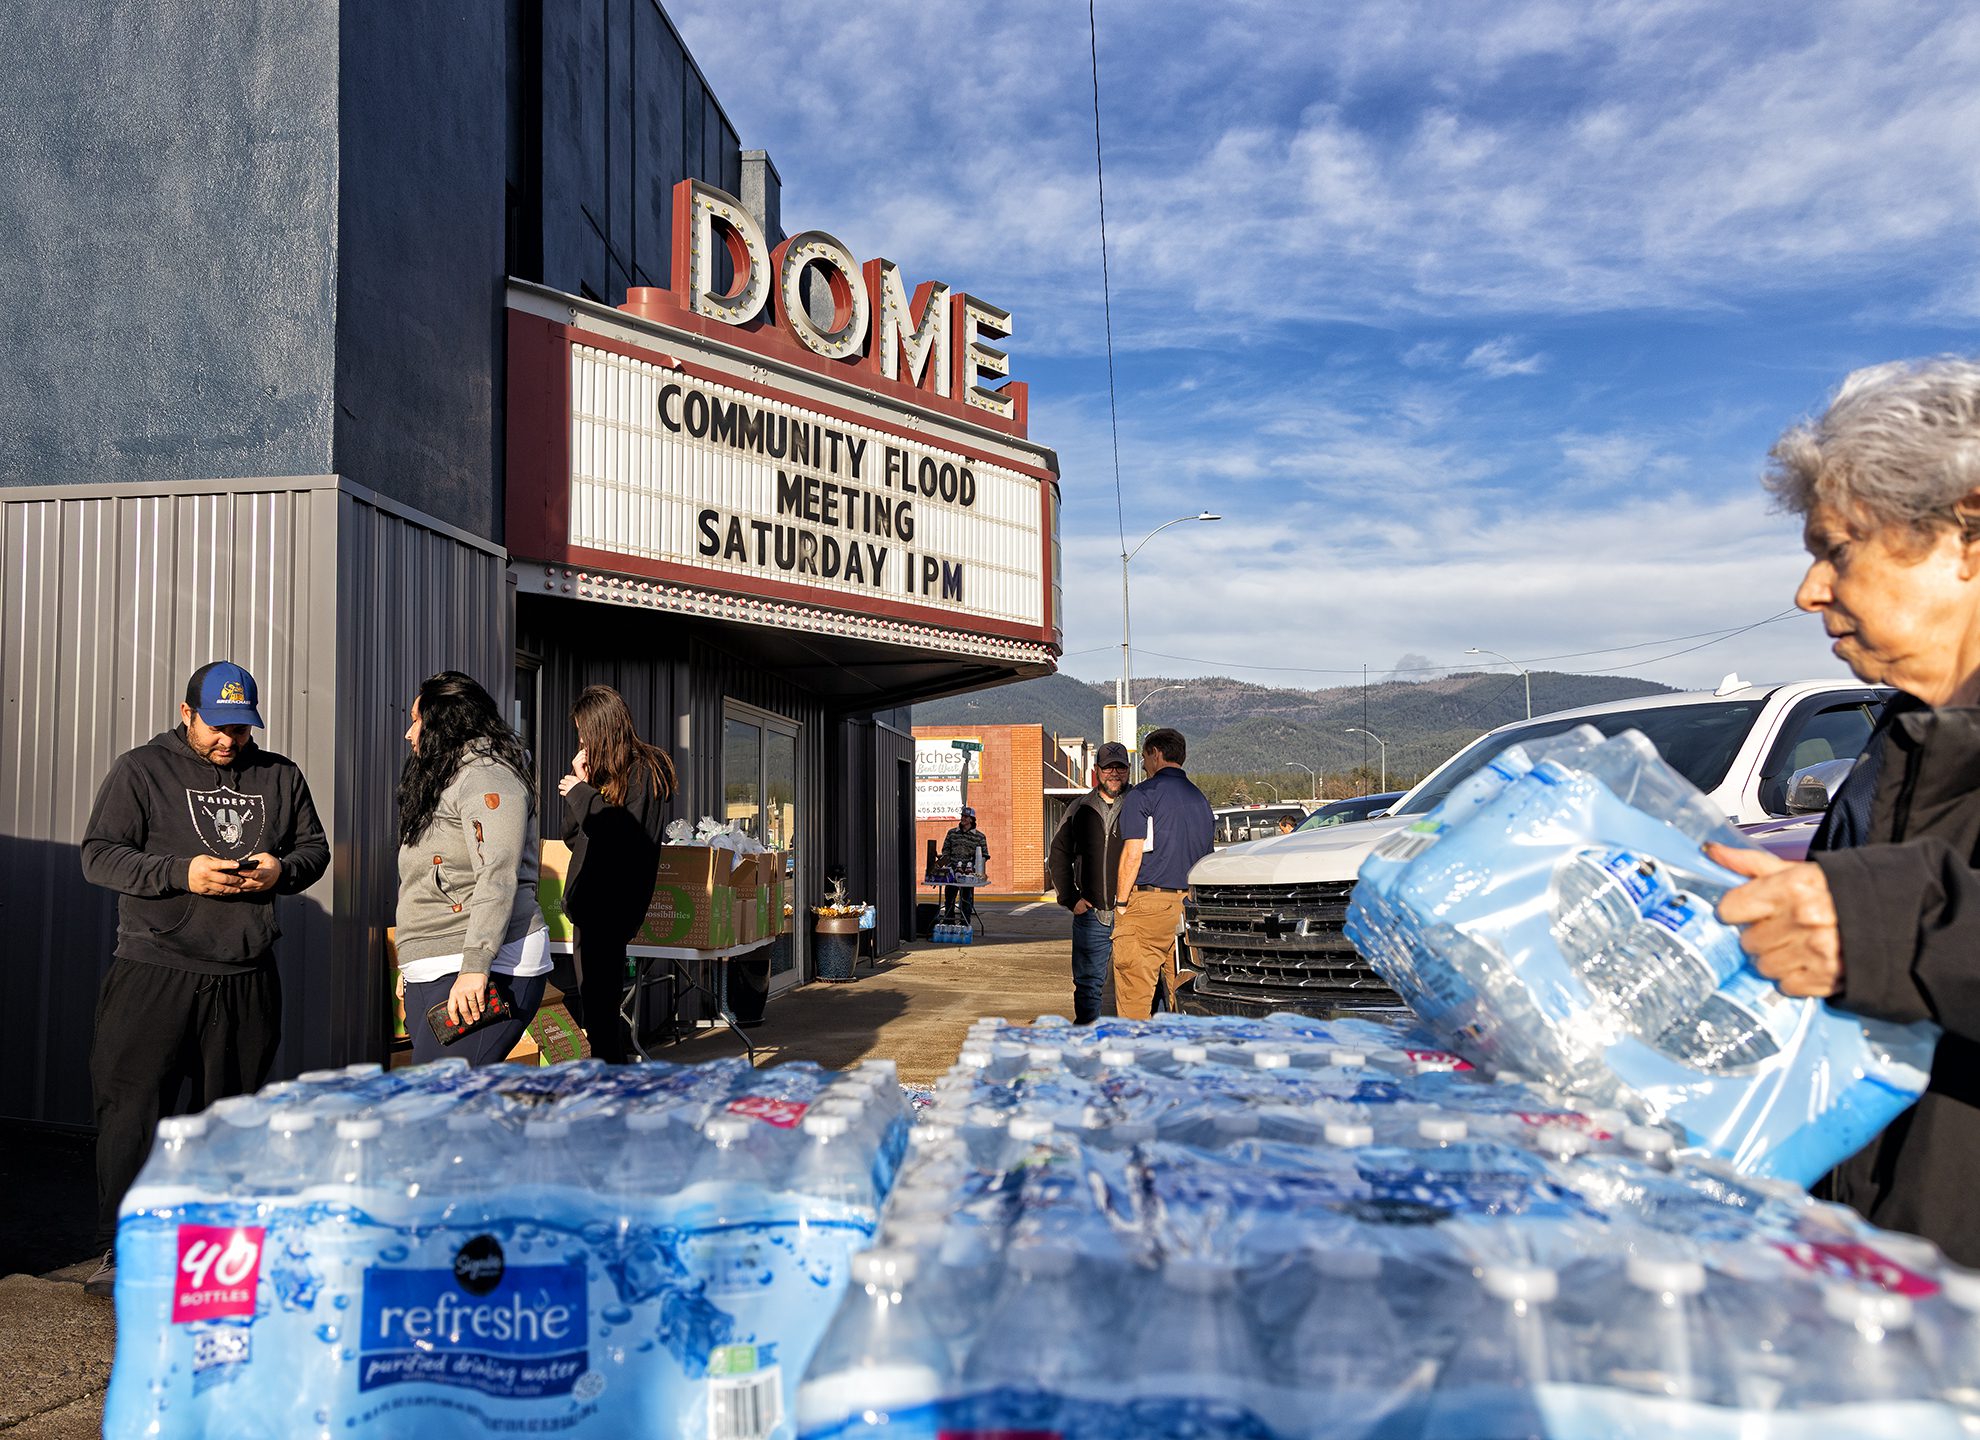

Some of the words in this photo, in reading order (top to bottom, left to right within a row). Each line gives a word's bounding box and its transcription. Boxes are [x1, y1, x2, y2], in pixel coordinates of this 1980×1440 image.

[673, 178, 1016, 420] DOME
[657, 384, 867, 478] COMMUNITY
[885, 446, 976, 507] FLOOD
[777, 470, 914, 542] MEETING
[698, 509, 888, 587] SATURDAY
[197, 795, 255, 807] RAIDERS
[645, 910, 691, 920] ossibilities
[648, 902, 673, 911] ndless
[181, 1238, 258, 1288] 40
[179, 1289, 250, 1307] BOTTLES
[365, 1353, 449, 1383] purified
[453, 1354, 517, 1387] drinking
[521, 1361, 580, 1383] water
